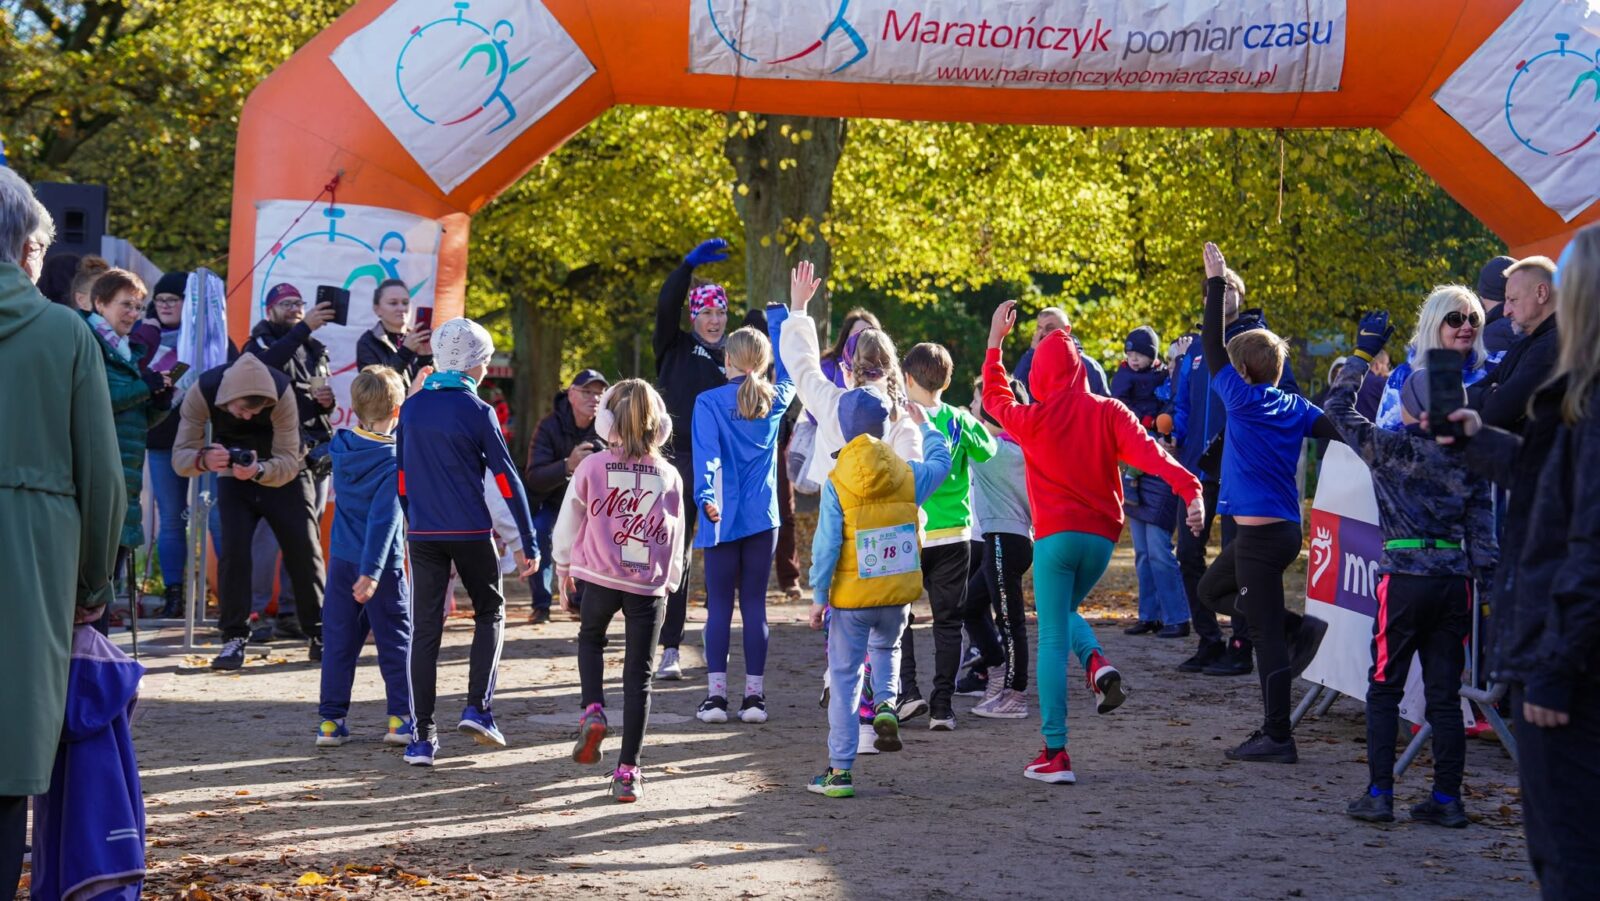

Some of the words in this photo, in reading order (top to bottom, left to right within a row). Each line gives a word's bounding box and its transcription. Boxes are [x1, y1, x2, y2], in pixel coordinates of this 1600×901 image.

[881, 9, 1112, 59] Maratończyk
[1122, 19, 1333, 60] pomiarczasu
[605, 462, 629, 470] COOL
[590, 487, 653, 517] New
[613, 513, 668, 545] York
[883, 546, 897, 559] 18
